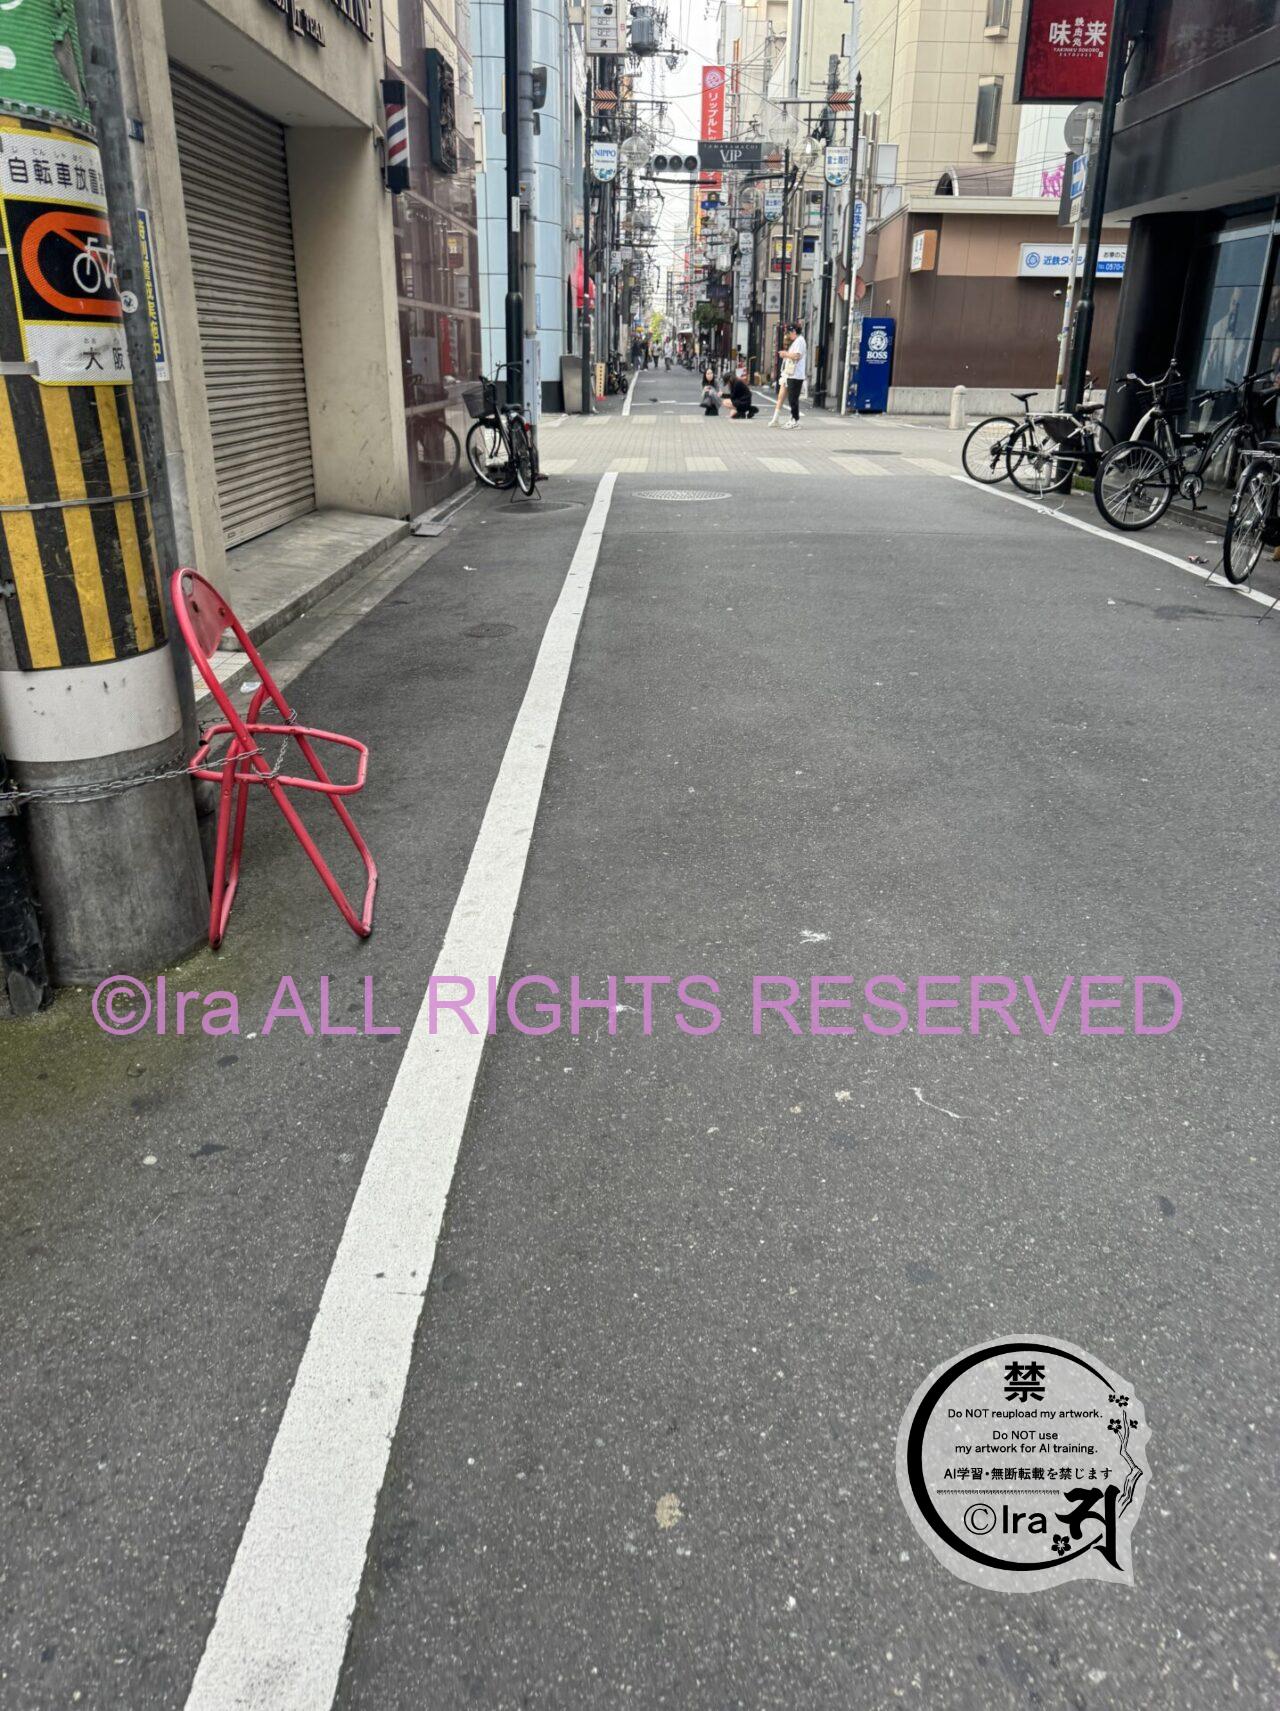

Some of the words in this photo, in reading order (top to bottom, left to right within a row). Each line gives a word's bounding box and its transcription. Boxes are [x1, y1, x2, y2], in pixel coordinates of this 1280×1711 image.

[594, 149, 616, 157] NIPPO
[720, 149, 743, 163] VIP
[8, 156, 104, 196] 自転車放置
[866, 351, 888, 360] BOSS
